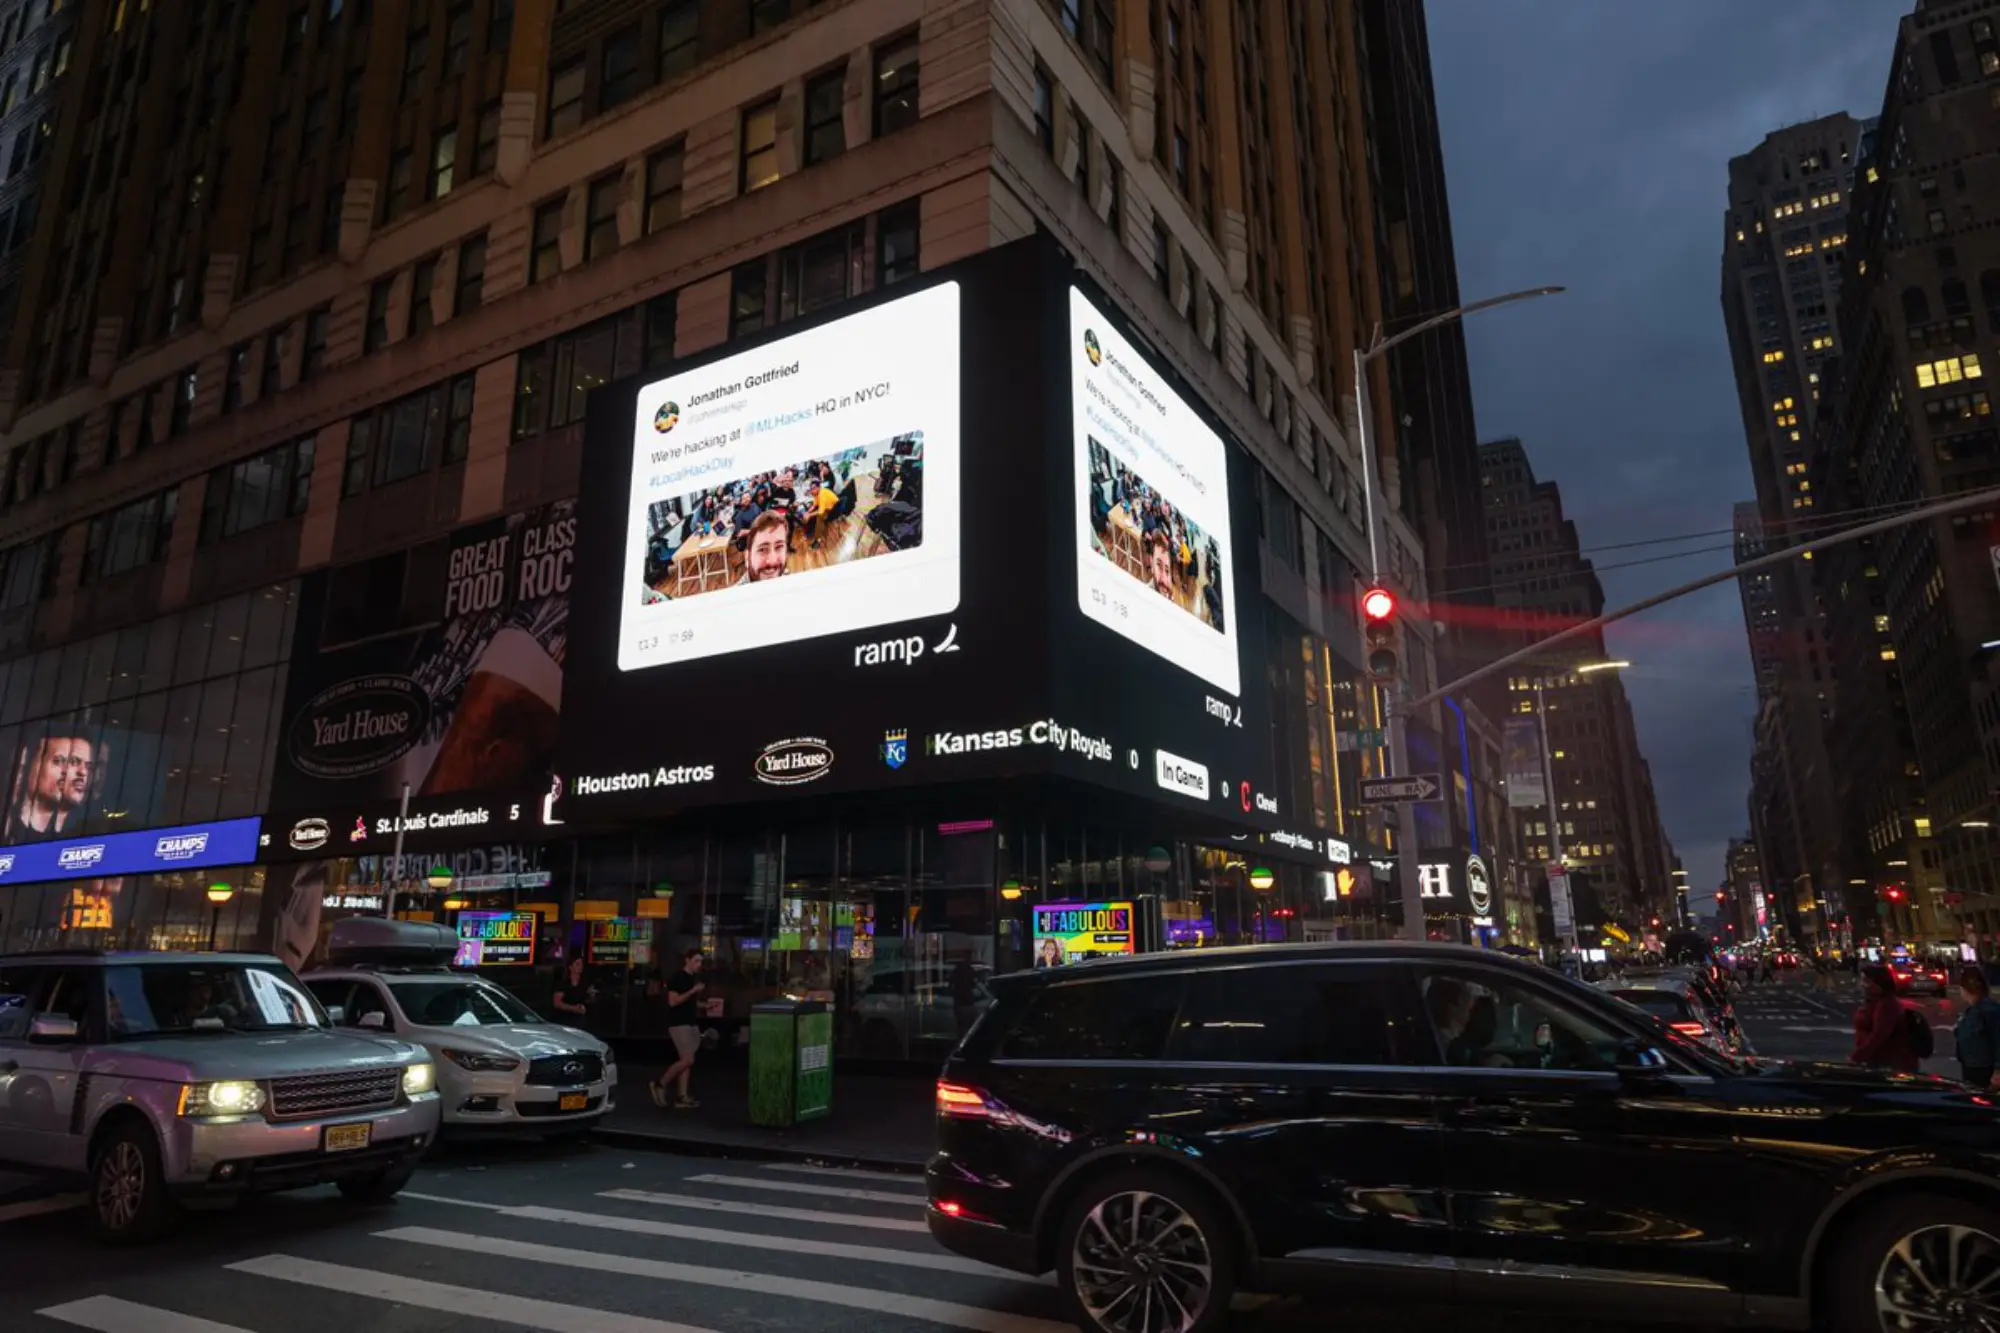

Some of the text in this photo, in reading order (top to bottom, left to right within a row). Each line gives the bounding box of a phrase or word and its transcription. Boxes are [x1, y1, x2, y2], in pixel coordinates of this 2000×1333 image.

[686, 360, 800, 409] Jonathan Gottfried
[651, 381, 892, 465] We're hacking at @MLHacks HQ in NYC!
[649, 455, 735, 488] #LocalHackDay
[523, 517, 578, 558] CLASS
[449, 535, 510, 580] GREAT
[518, 548, 575, 601] ROC
[444, 570, 505, 619] FOOD
[854, 635, 924, 668] ramp
[1206, 695, 1233, 727] ramp
[312, 708, 409, 747] Yard House
[934, 718, 1113, 761] Kansas City Royals
[764, 751, 827, 772] Yard House
[1130, 749, 1139, 769] 0
[577, 764, 714, 795] Houston Astros
[1162, 760, 1204, 791] In Game
[1371, 783, 1429, 797] ONE WAY
[376, 817, 393, 834] St.
[429, 806, 489, 829] Cardinals
[509, 803, 521, 820] 5
[60, 846, 102, 863] CHAMPS
[157, 836, 206, 853] CHAMPS
[472, 920, 531, 937] FABULOUS
[1051, 909, 1127, 931] FABULOUS
